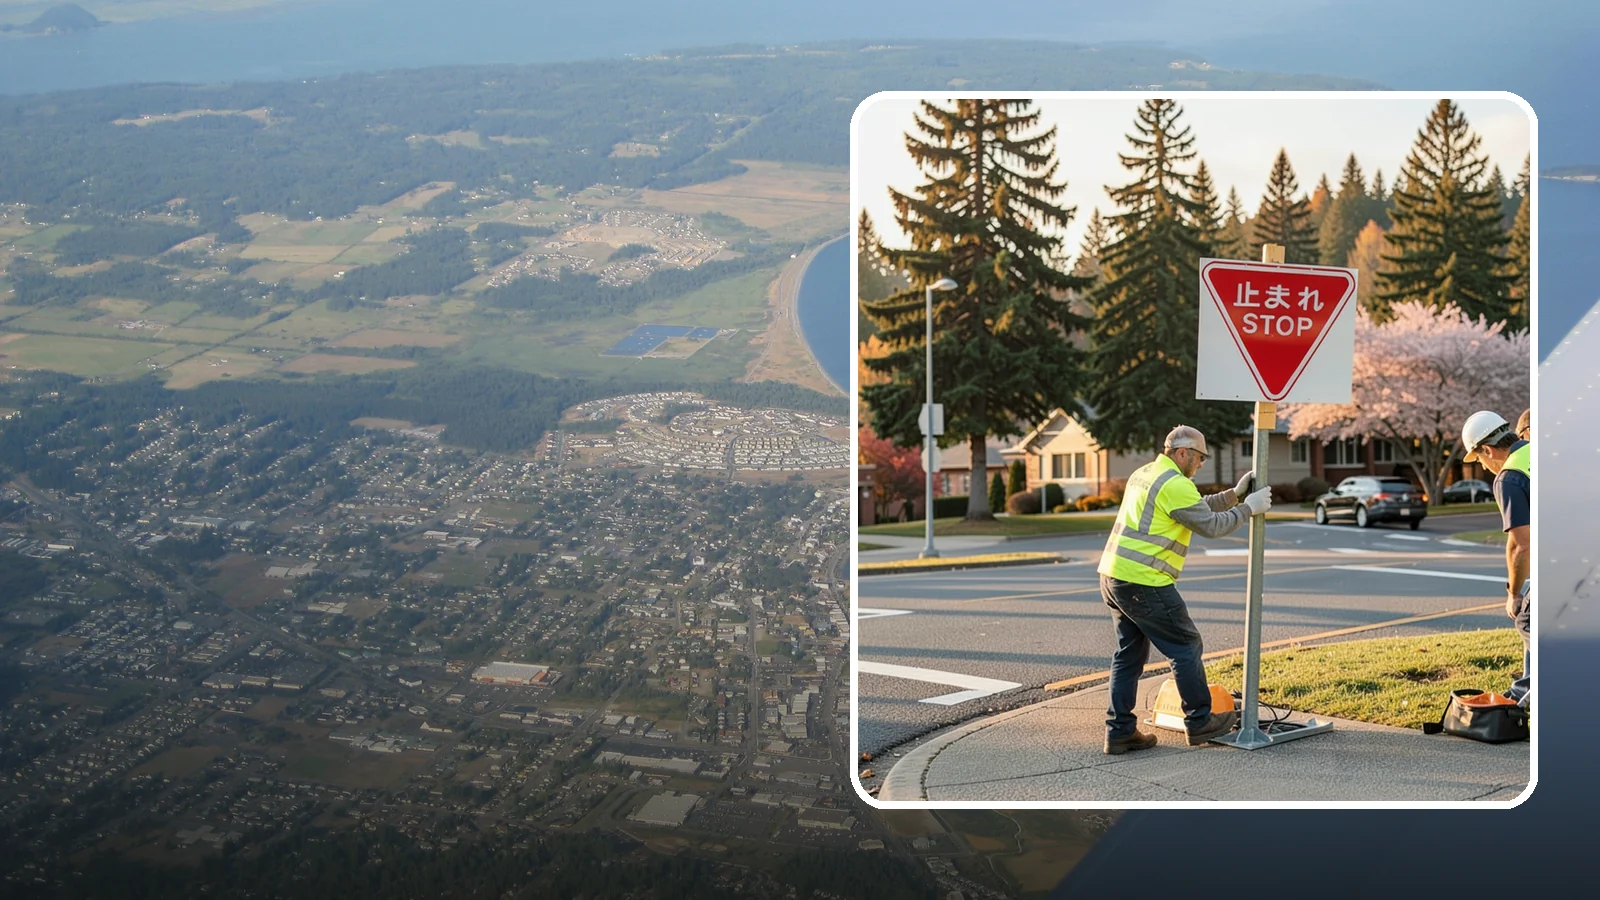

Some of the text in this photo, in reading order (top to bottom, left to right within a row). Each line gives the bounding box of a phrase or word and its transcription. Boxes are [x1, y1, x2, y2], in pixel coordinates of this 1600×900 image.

[1233, 281, 1324, 312] 止まれ
[1242, 313, 1313, 337] STOP
